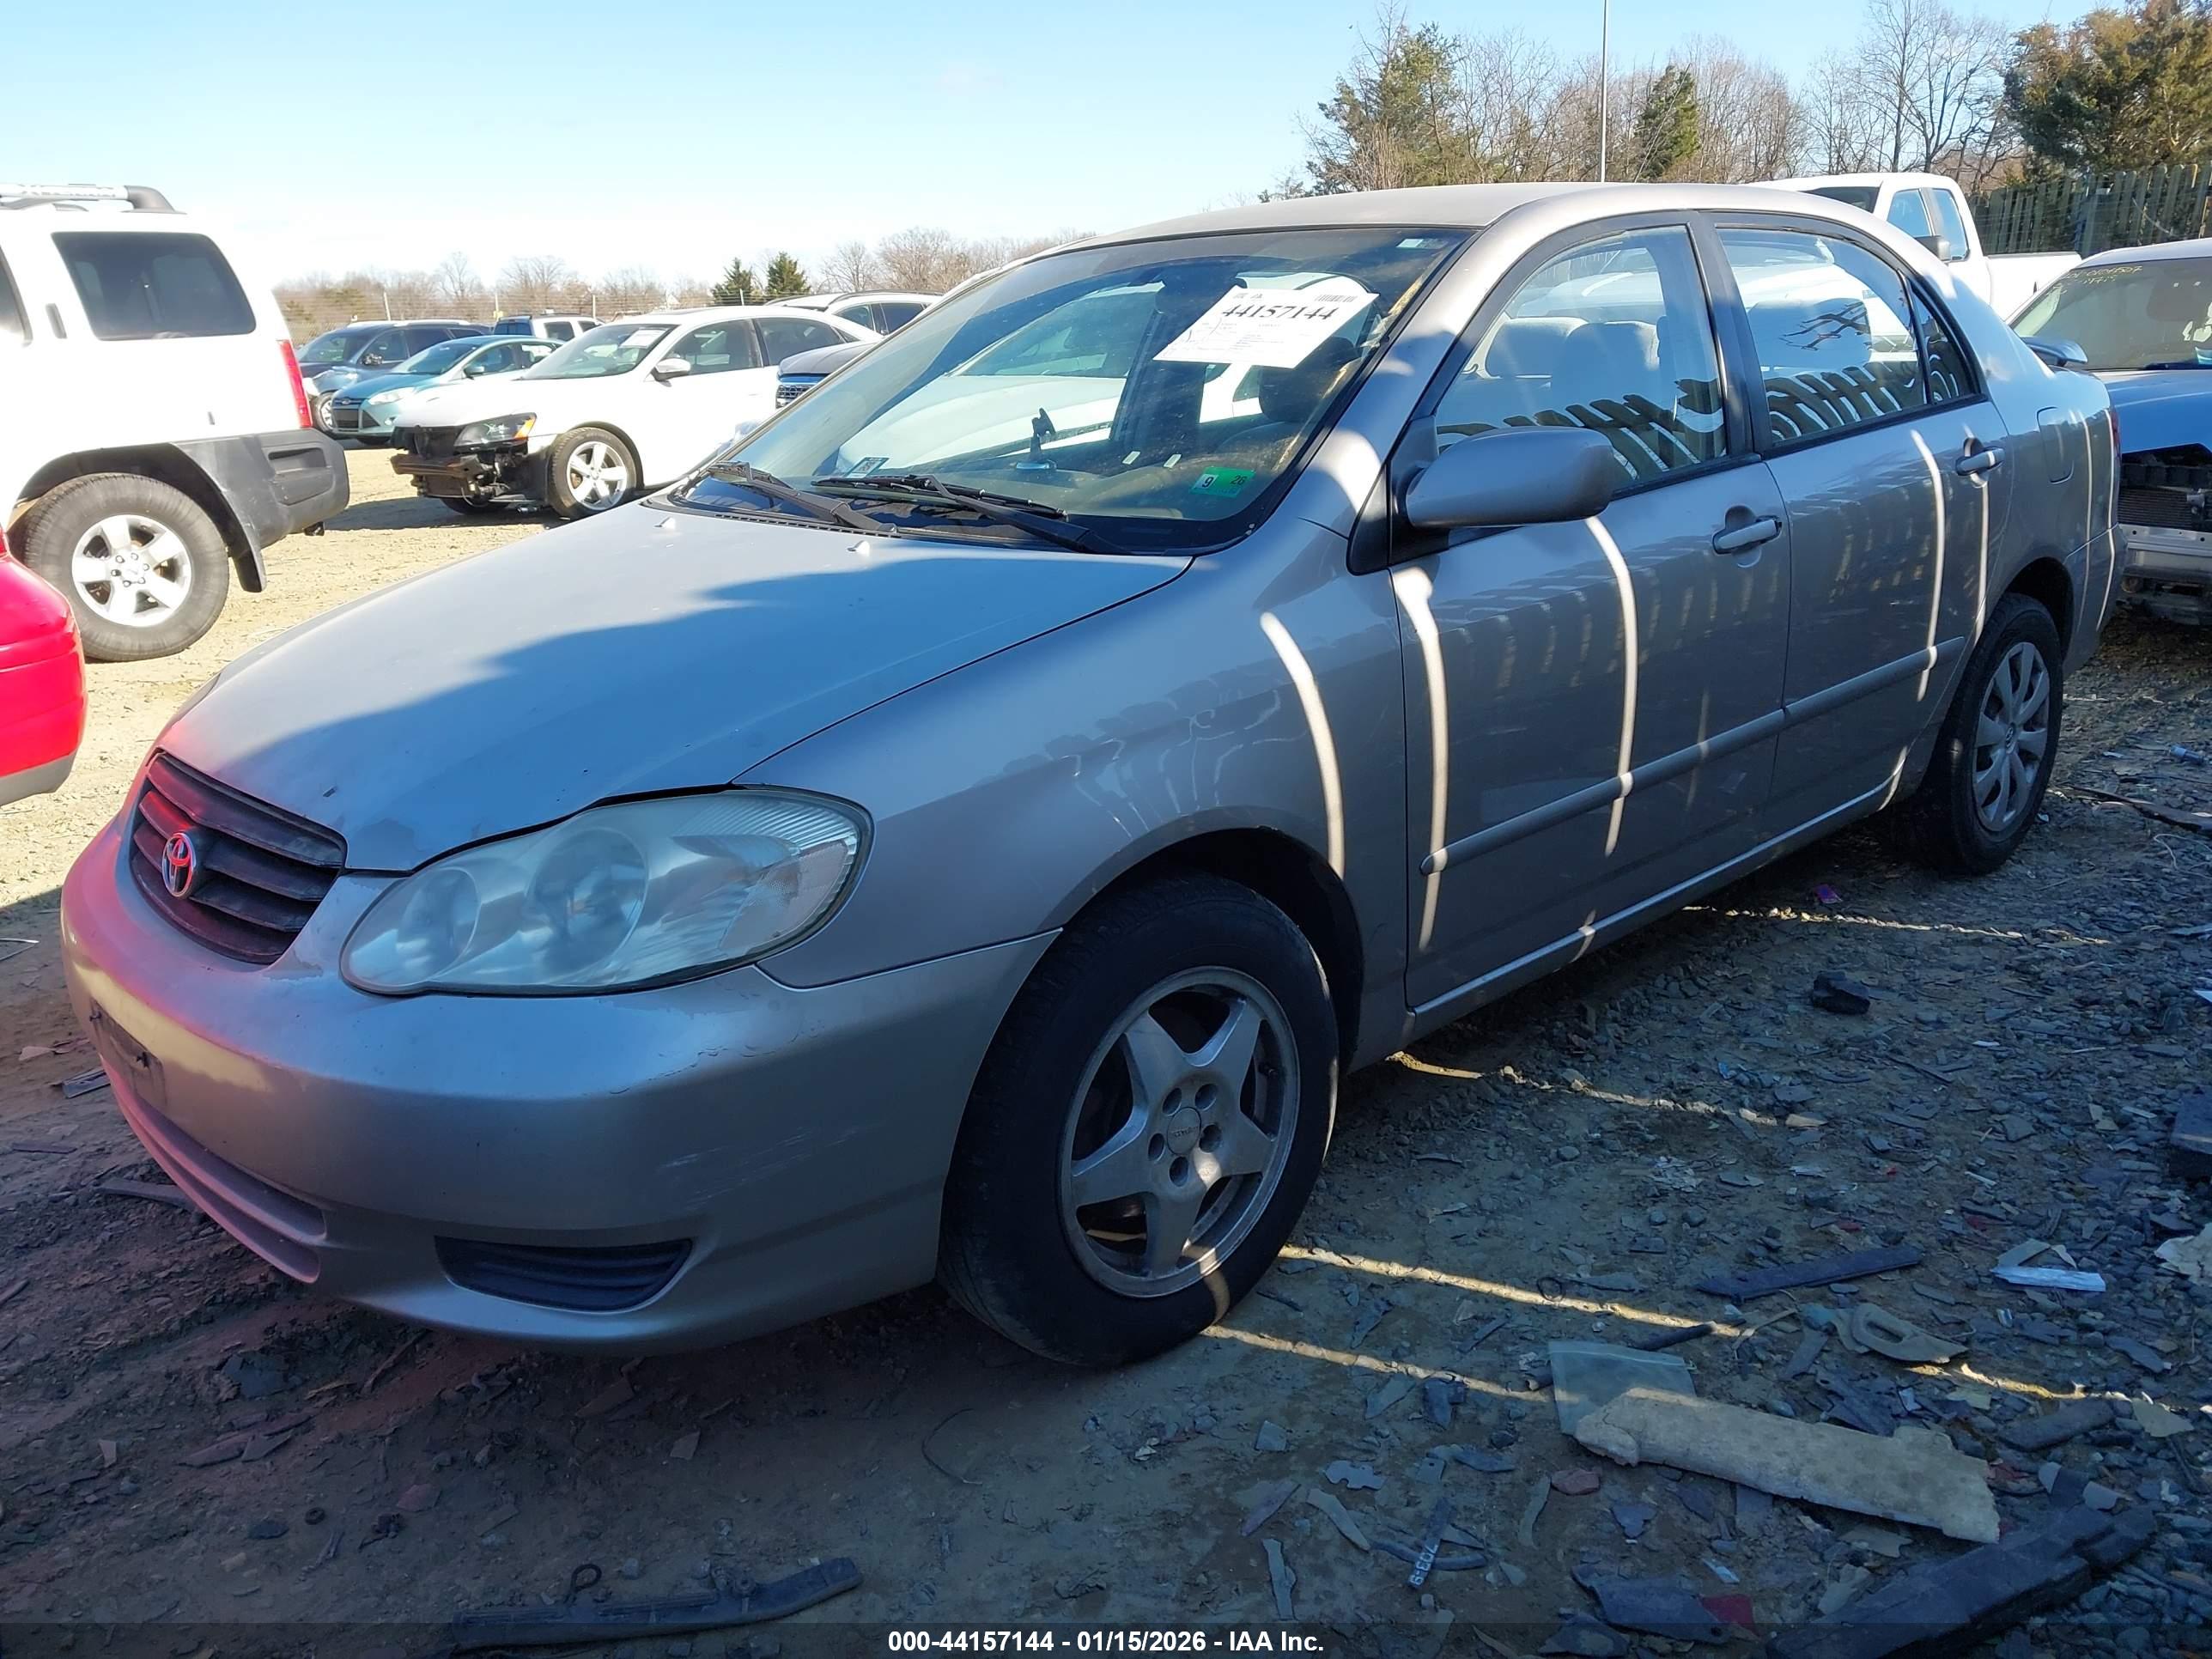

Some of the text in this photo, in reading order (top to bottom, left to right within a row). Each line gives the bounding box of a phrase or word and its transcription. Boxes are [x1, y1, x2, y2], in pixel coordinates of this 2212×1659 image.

[1222, 304, 1340, 320] 44157144
[1202, 475, 1248, 488] 9 26
